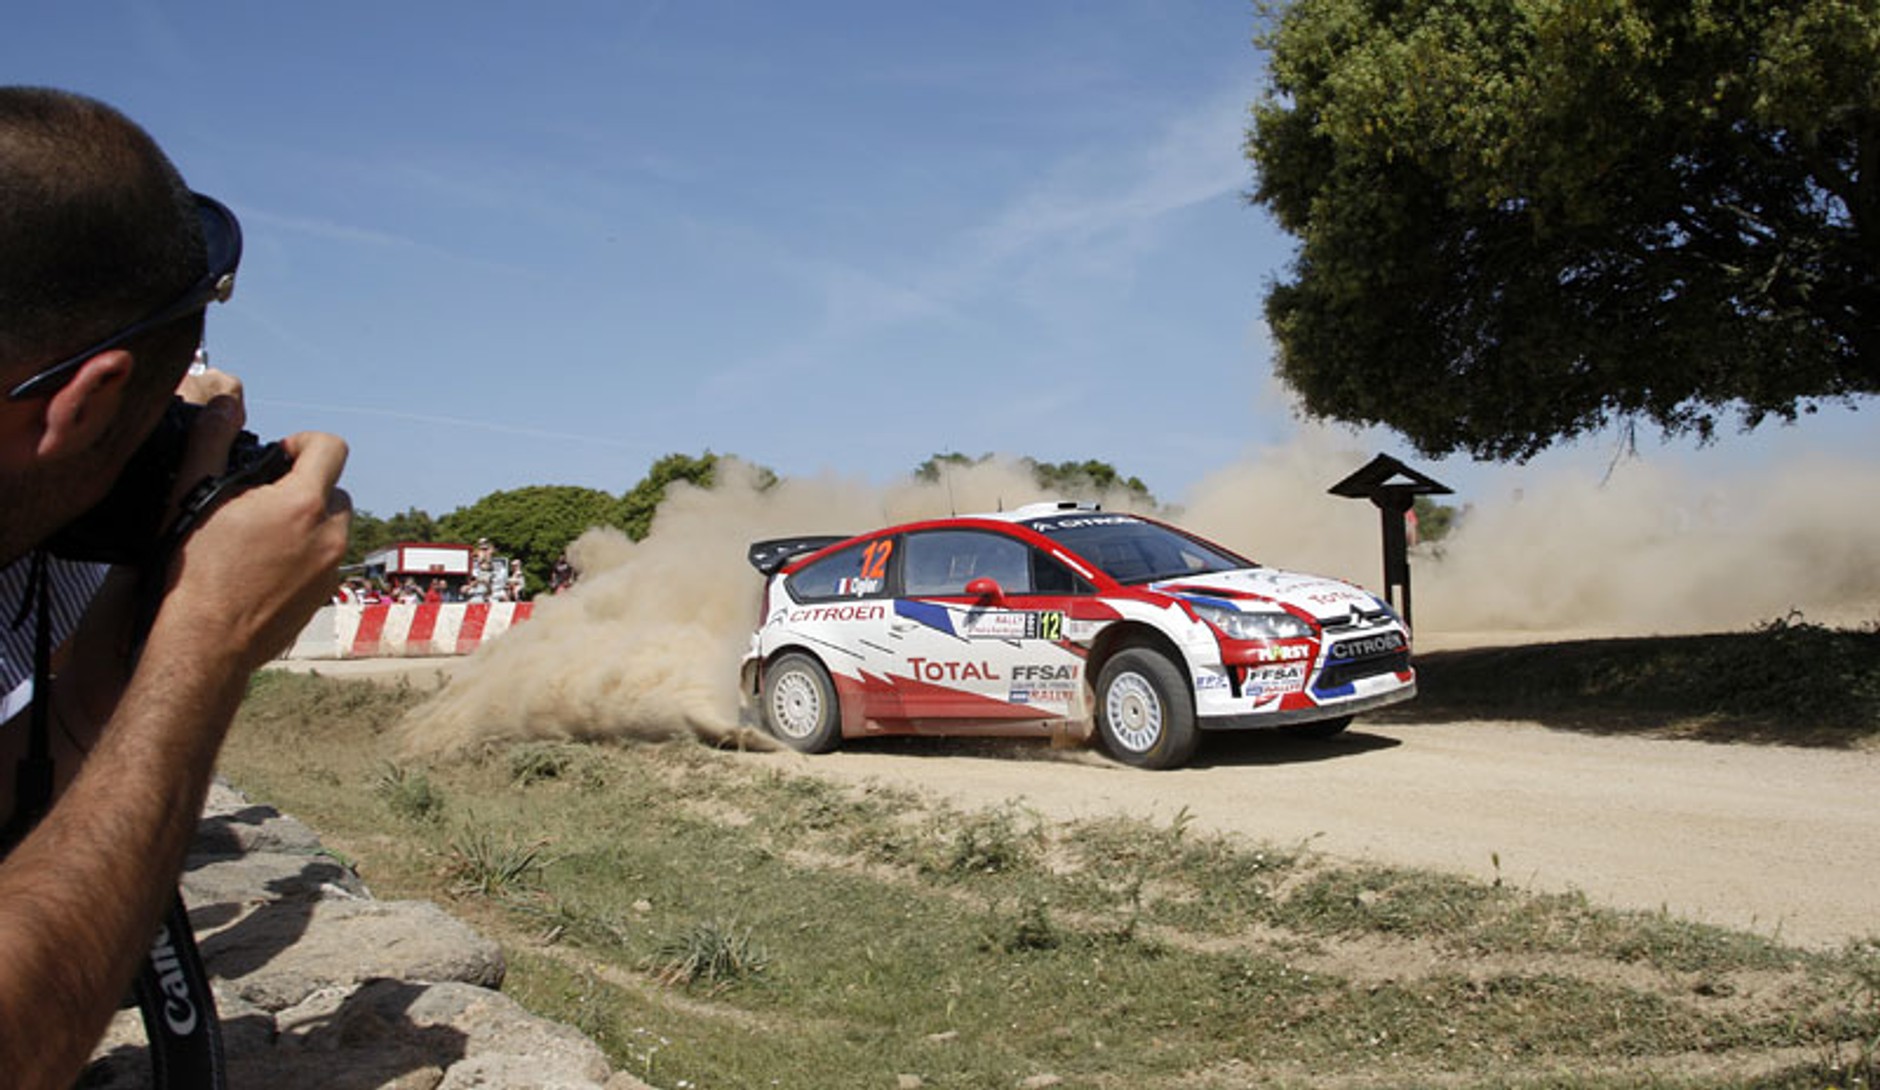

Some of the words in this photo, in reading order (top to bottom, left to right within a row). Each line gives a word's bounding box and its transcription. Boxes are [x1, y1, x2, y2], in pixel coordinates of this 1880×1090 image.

[861, 539, 893, 578] 12
[1042, 612, 1060, 639] 12
[906, 657, 1001, 681] TOTAL
